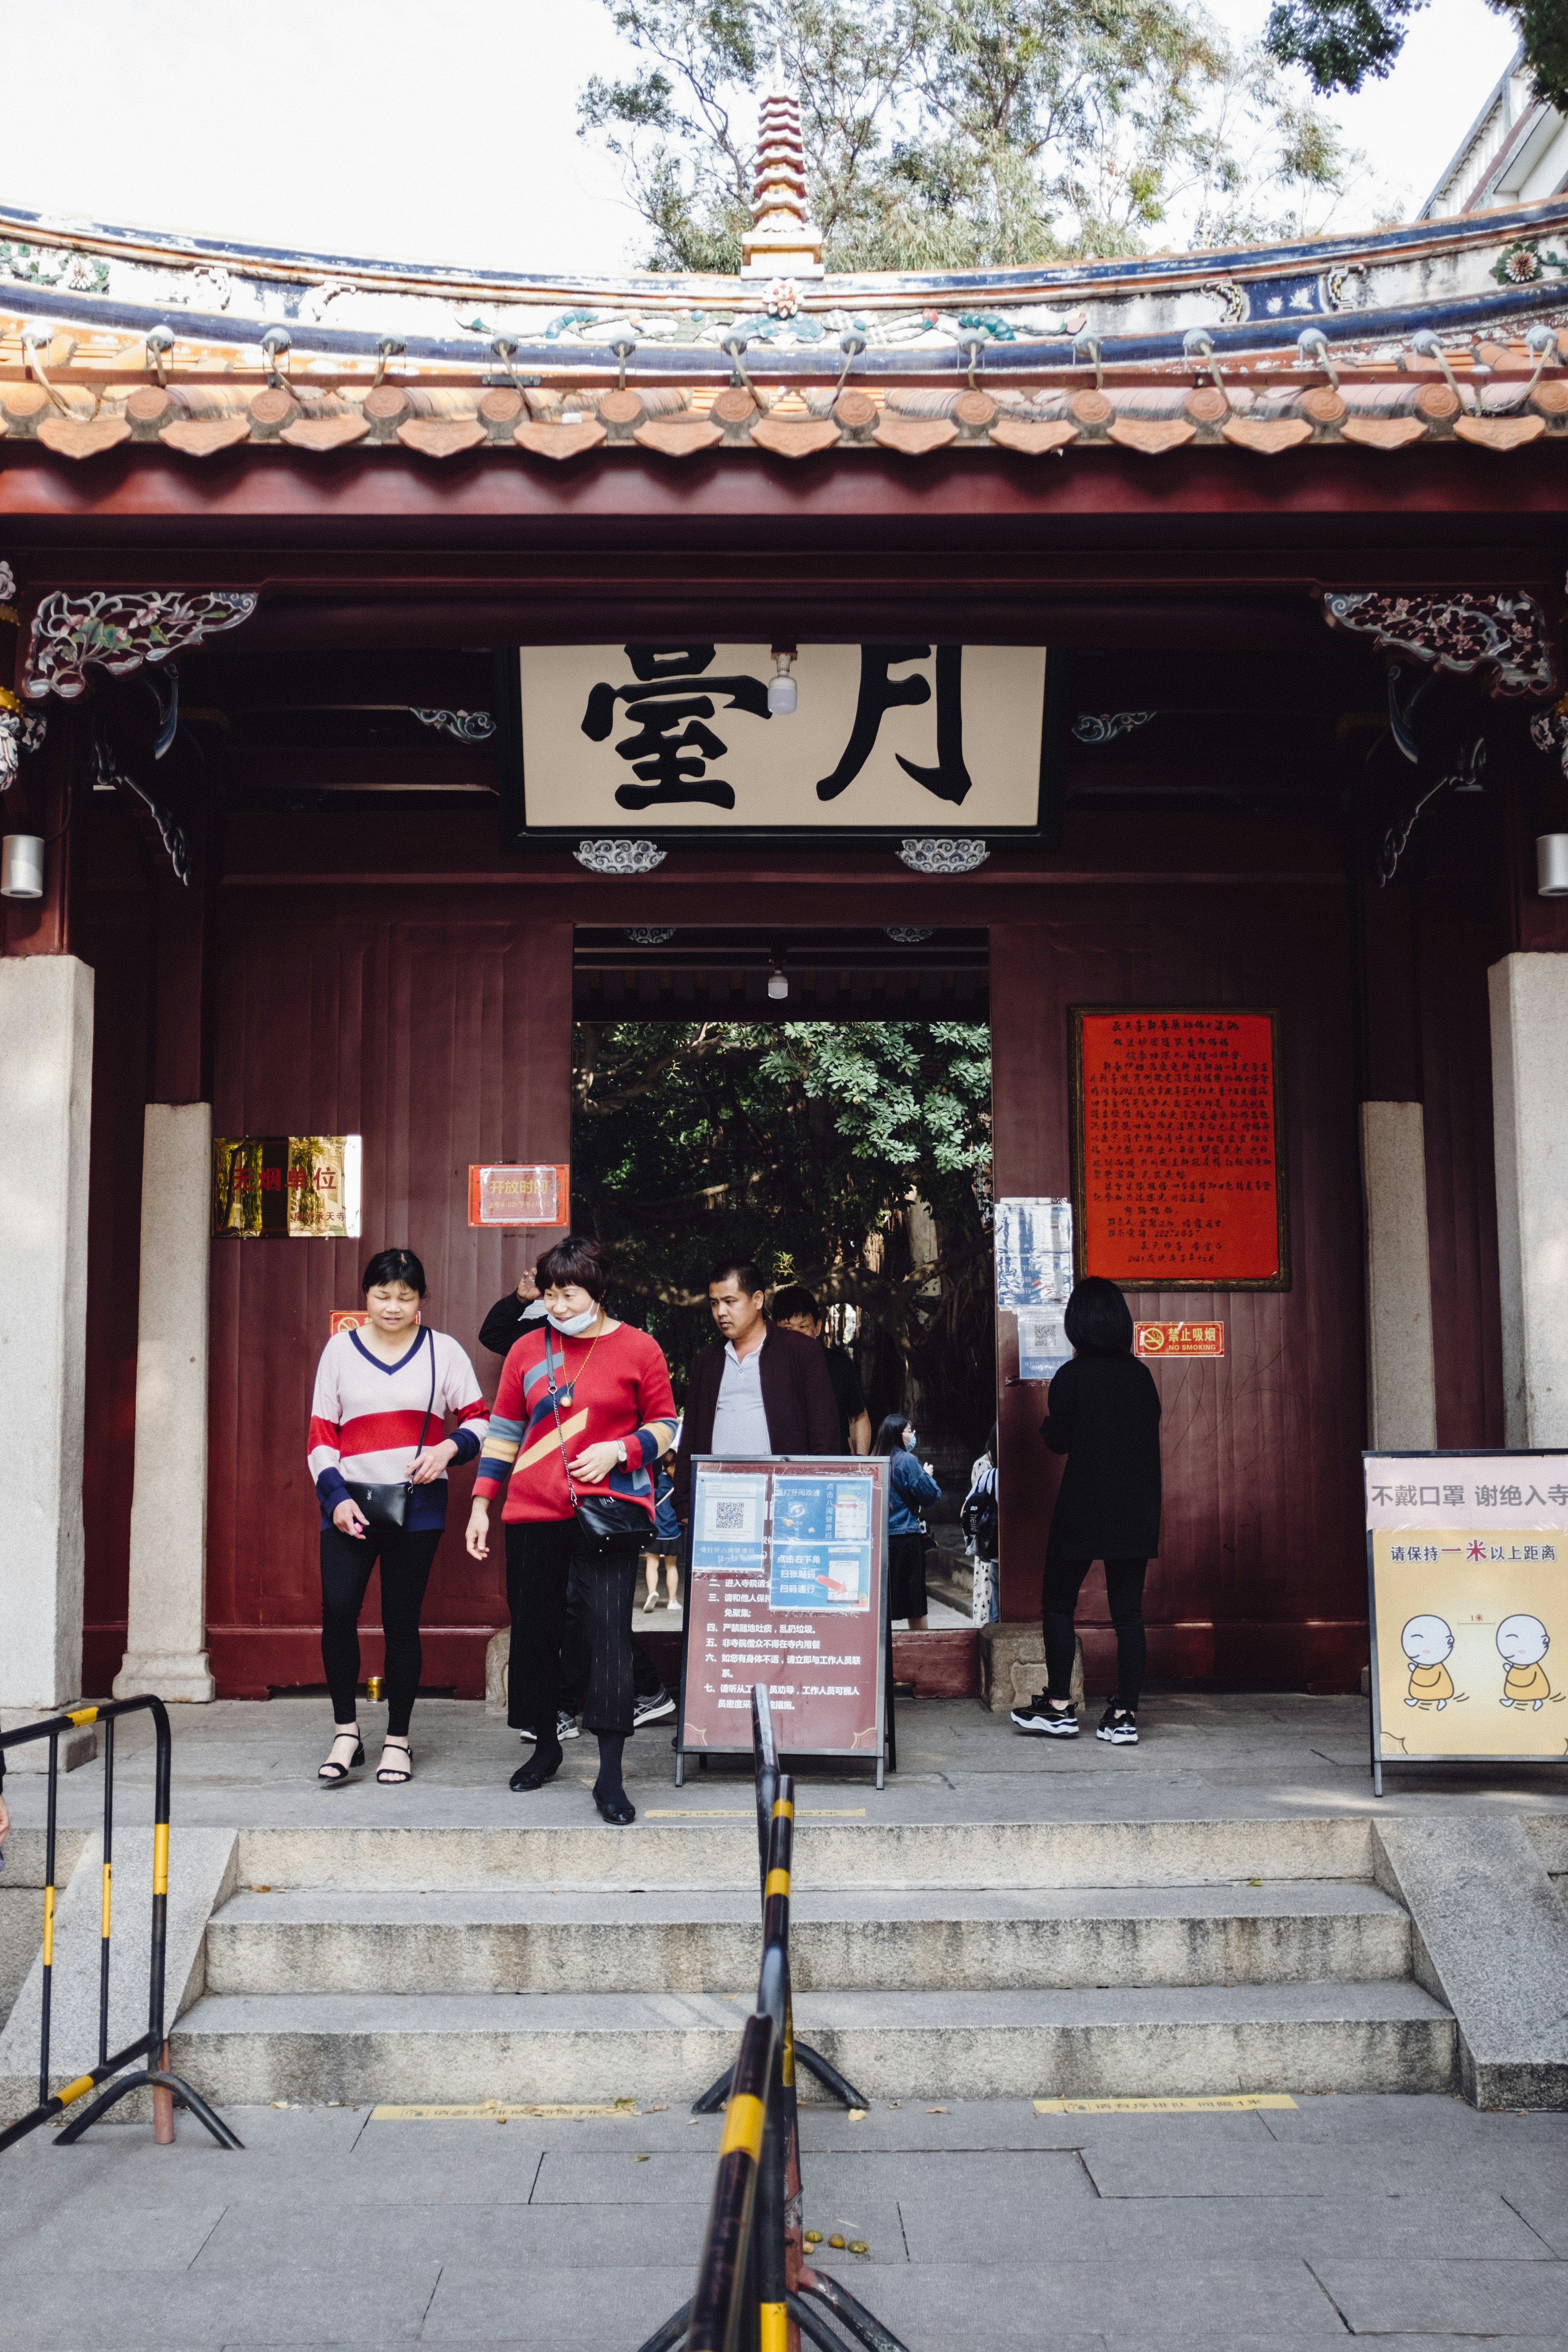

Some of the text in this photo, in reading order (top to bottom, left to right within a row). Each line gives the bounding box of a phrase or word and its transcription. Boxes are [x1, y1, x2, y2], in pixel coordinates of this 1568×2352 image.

[232, 1167, 336, 1191] 无烟单位
[490, 1180, 548, 1194] 开放时间
[294, 1212, 346, 1221] 泉州承天寺
[1168, 1328, 1216, 1342] 禁止吸烟
[1372, 1484, 1568, 1507] 不戴口罩 谢绝入寺
[825, 1483, 834, 1539] 点击八闽健康码
[970, 1514, 978, 1532] hello
[1390, 1539, 1555, 1562] 请保持一米以上距离
[777, 1555, 820, 1564] 点击右下角
[780, 1569, 816, 1579] 扫张贴码
[780, 1584, 815, 1593] 扫码通行
[704, 1684, 860, 1696] 七、请听从工员劝导，工作人员可视人
